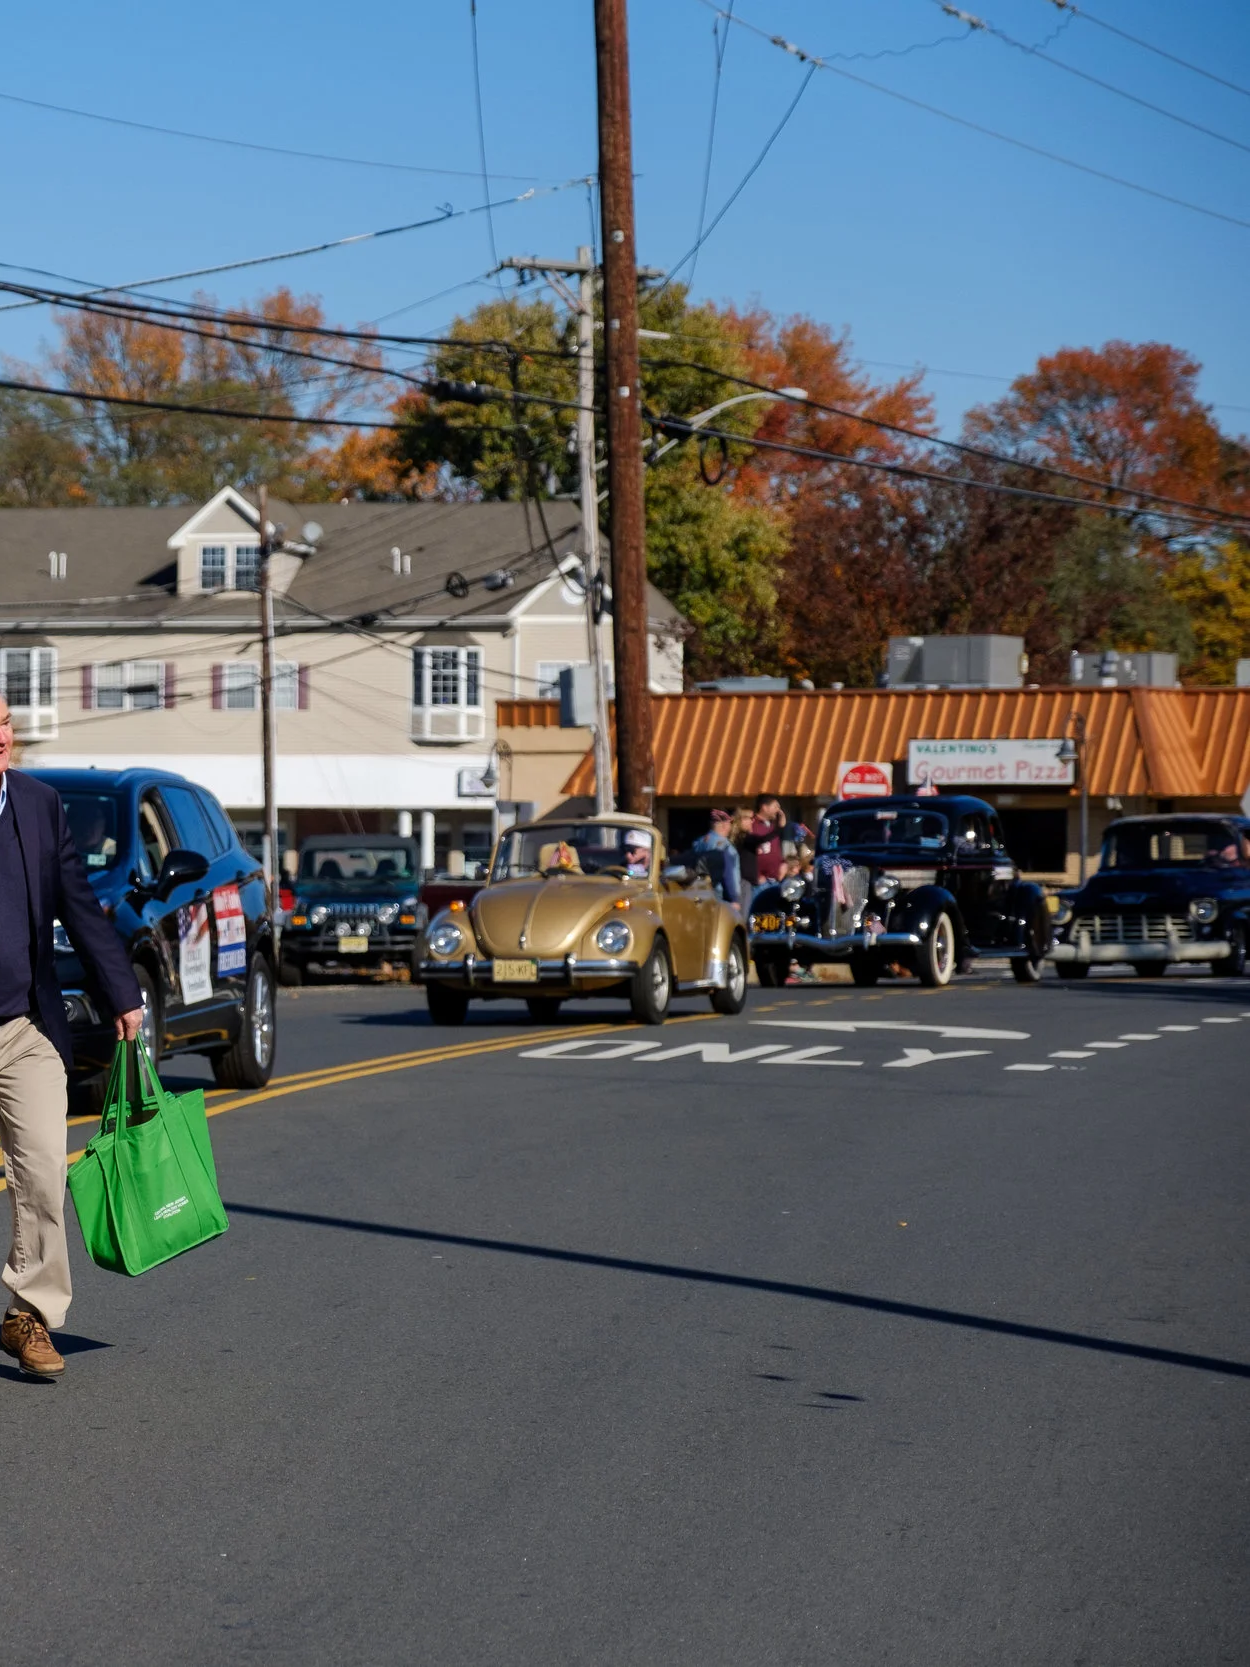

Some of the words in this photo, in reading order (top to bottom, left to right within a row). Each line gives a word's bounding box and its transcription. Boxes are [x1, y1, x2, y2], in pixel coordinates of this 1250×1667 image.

[915, 743, 998, 755] VALENTINO'S
[864, 772, 884, 783] NOT
[914, 760, 1009, 782] Gourmet
[1014, 760, 1068, 782] Pizza
[518, 1040, 994, 1068] ONLY
